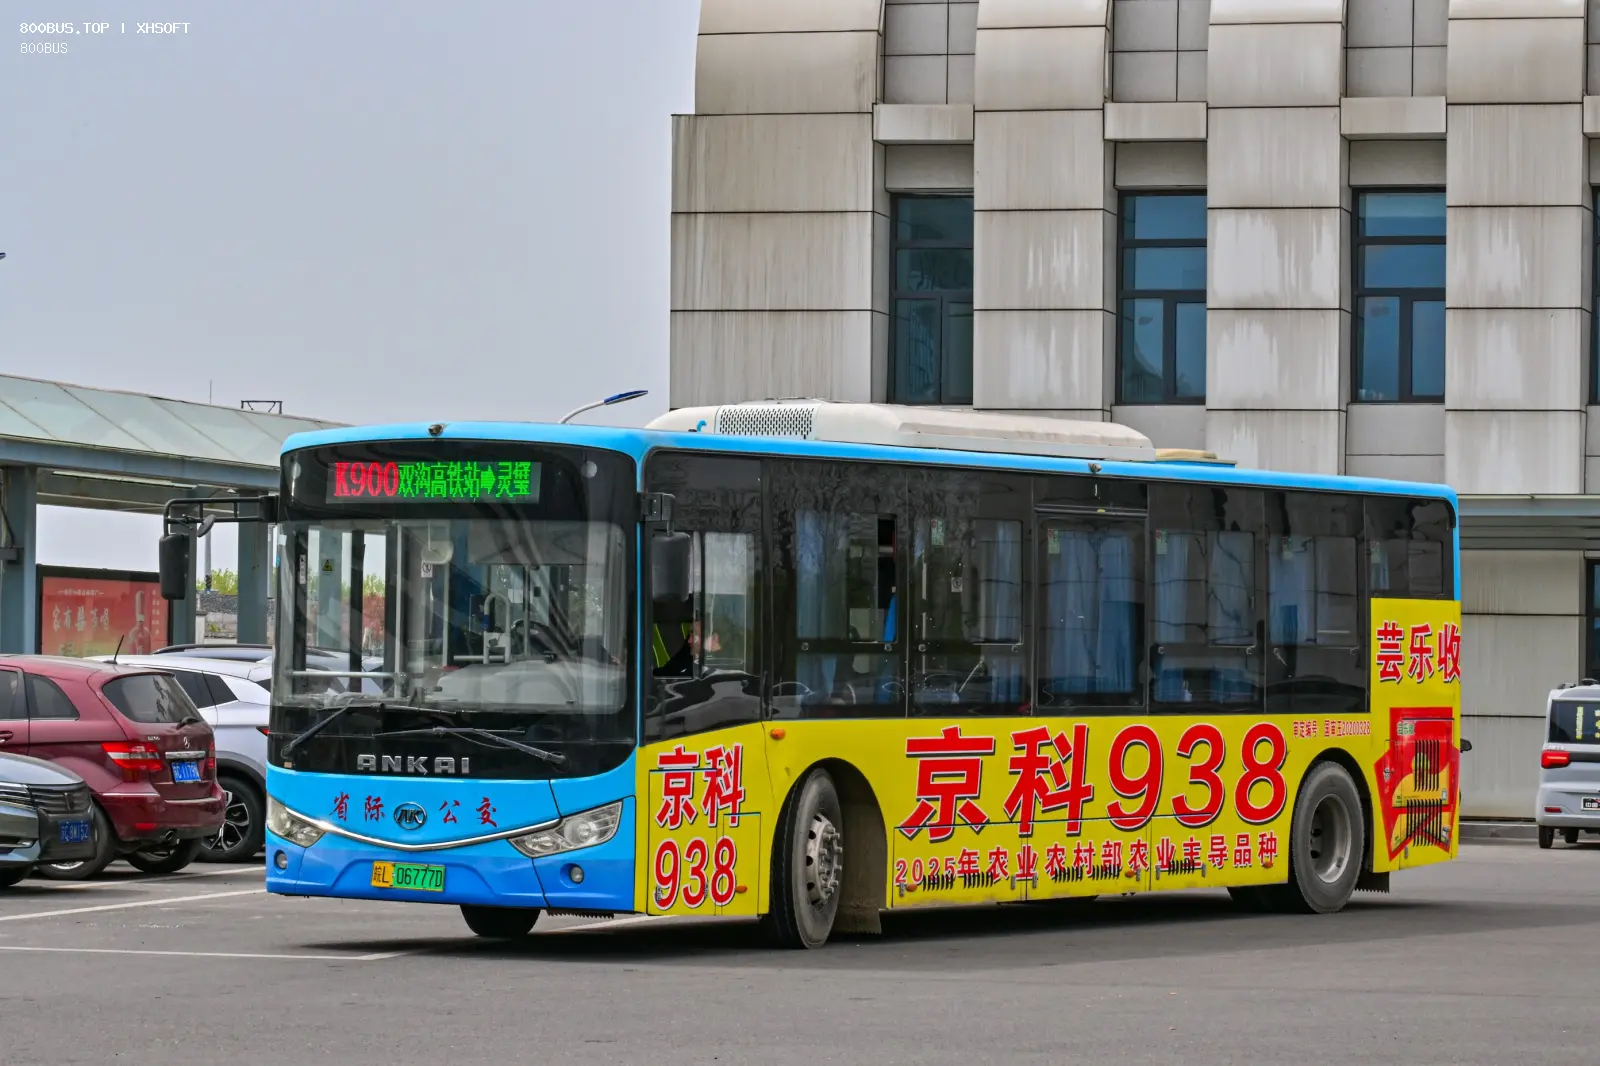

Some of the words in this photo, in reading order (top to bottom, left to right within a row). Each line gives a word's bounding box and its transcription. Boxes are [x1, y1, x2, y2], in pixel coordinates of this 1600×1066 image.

[334, 461, 399, 497] K900
[398, 461, 480, 498] 双沟高铁站
[496, 461, 531, 498] 灵璧
[357, 754, 470, 775] ANKAI
[655, 744, 744, 830] 京科
[900, 724, 1288, 841] 京科938
[329, 792, 385, 822] 省际
[439, 797, 498, 828] 公交
[653, 837, 737, 910] 938
